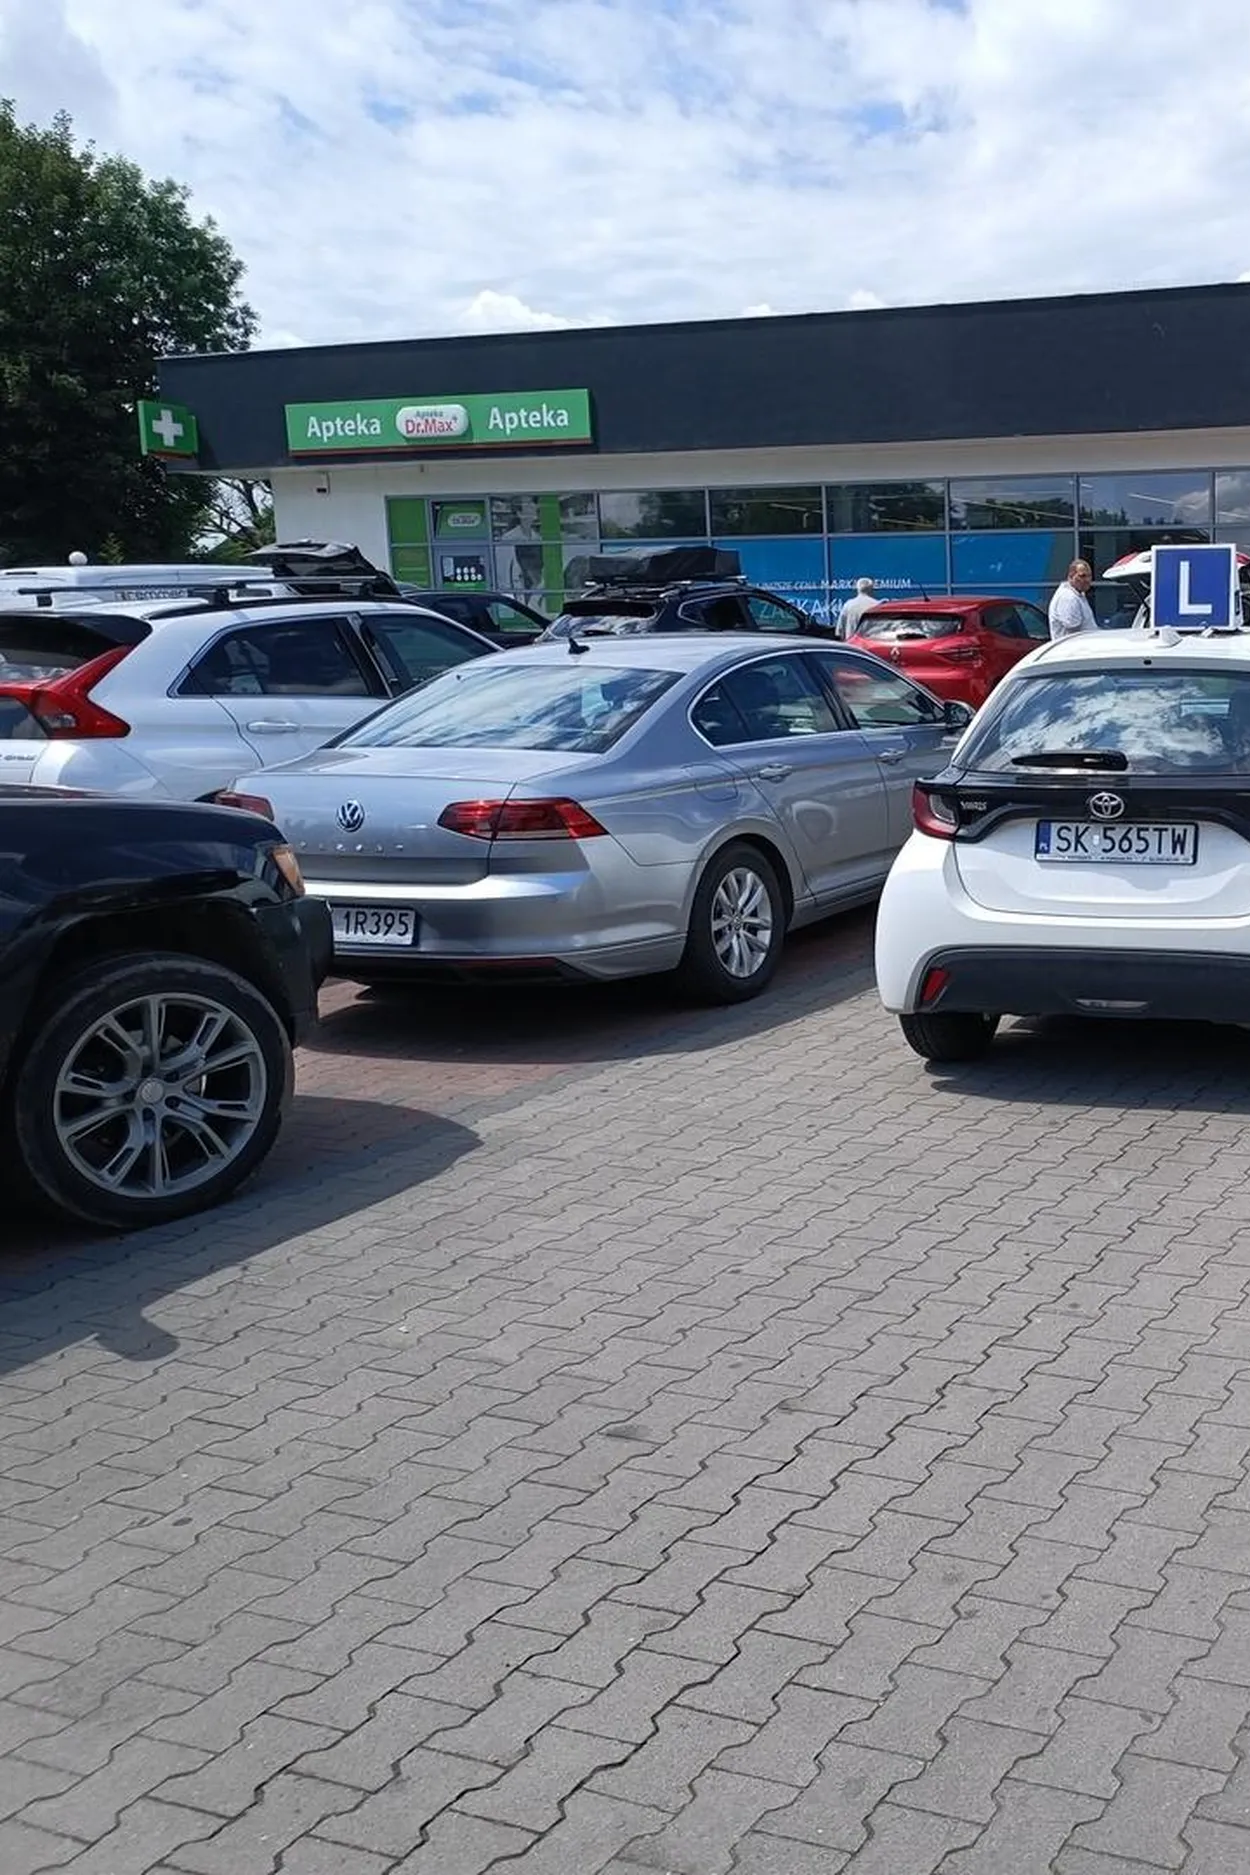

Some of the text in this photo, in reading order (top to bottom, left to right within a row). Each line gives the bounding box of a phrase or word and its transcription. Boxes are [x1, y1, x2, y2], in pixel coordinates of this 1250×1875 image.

[306, 412, 381, 441] Apteka
[488, 404, 570, 431] Apteka
[1179, 560, 1212, 615] L
[1056, 826, 1188, 855] SK 565TW
[343, 911, 409, 936] 1R395
